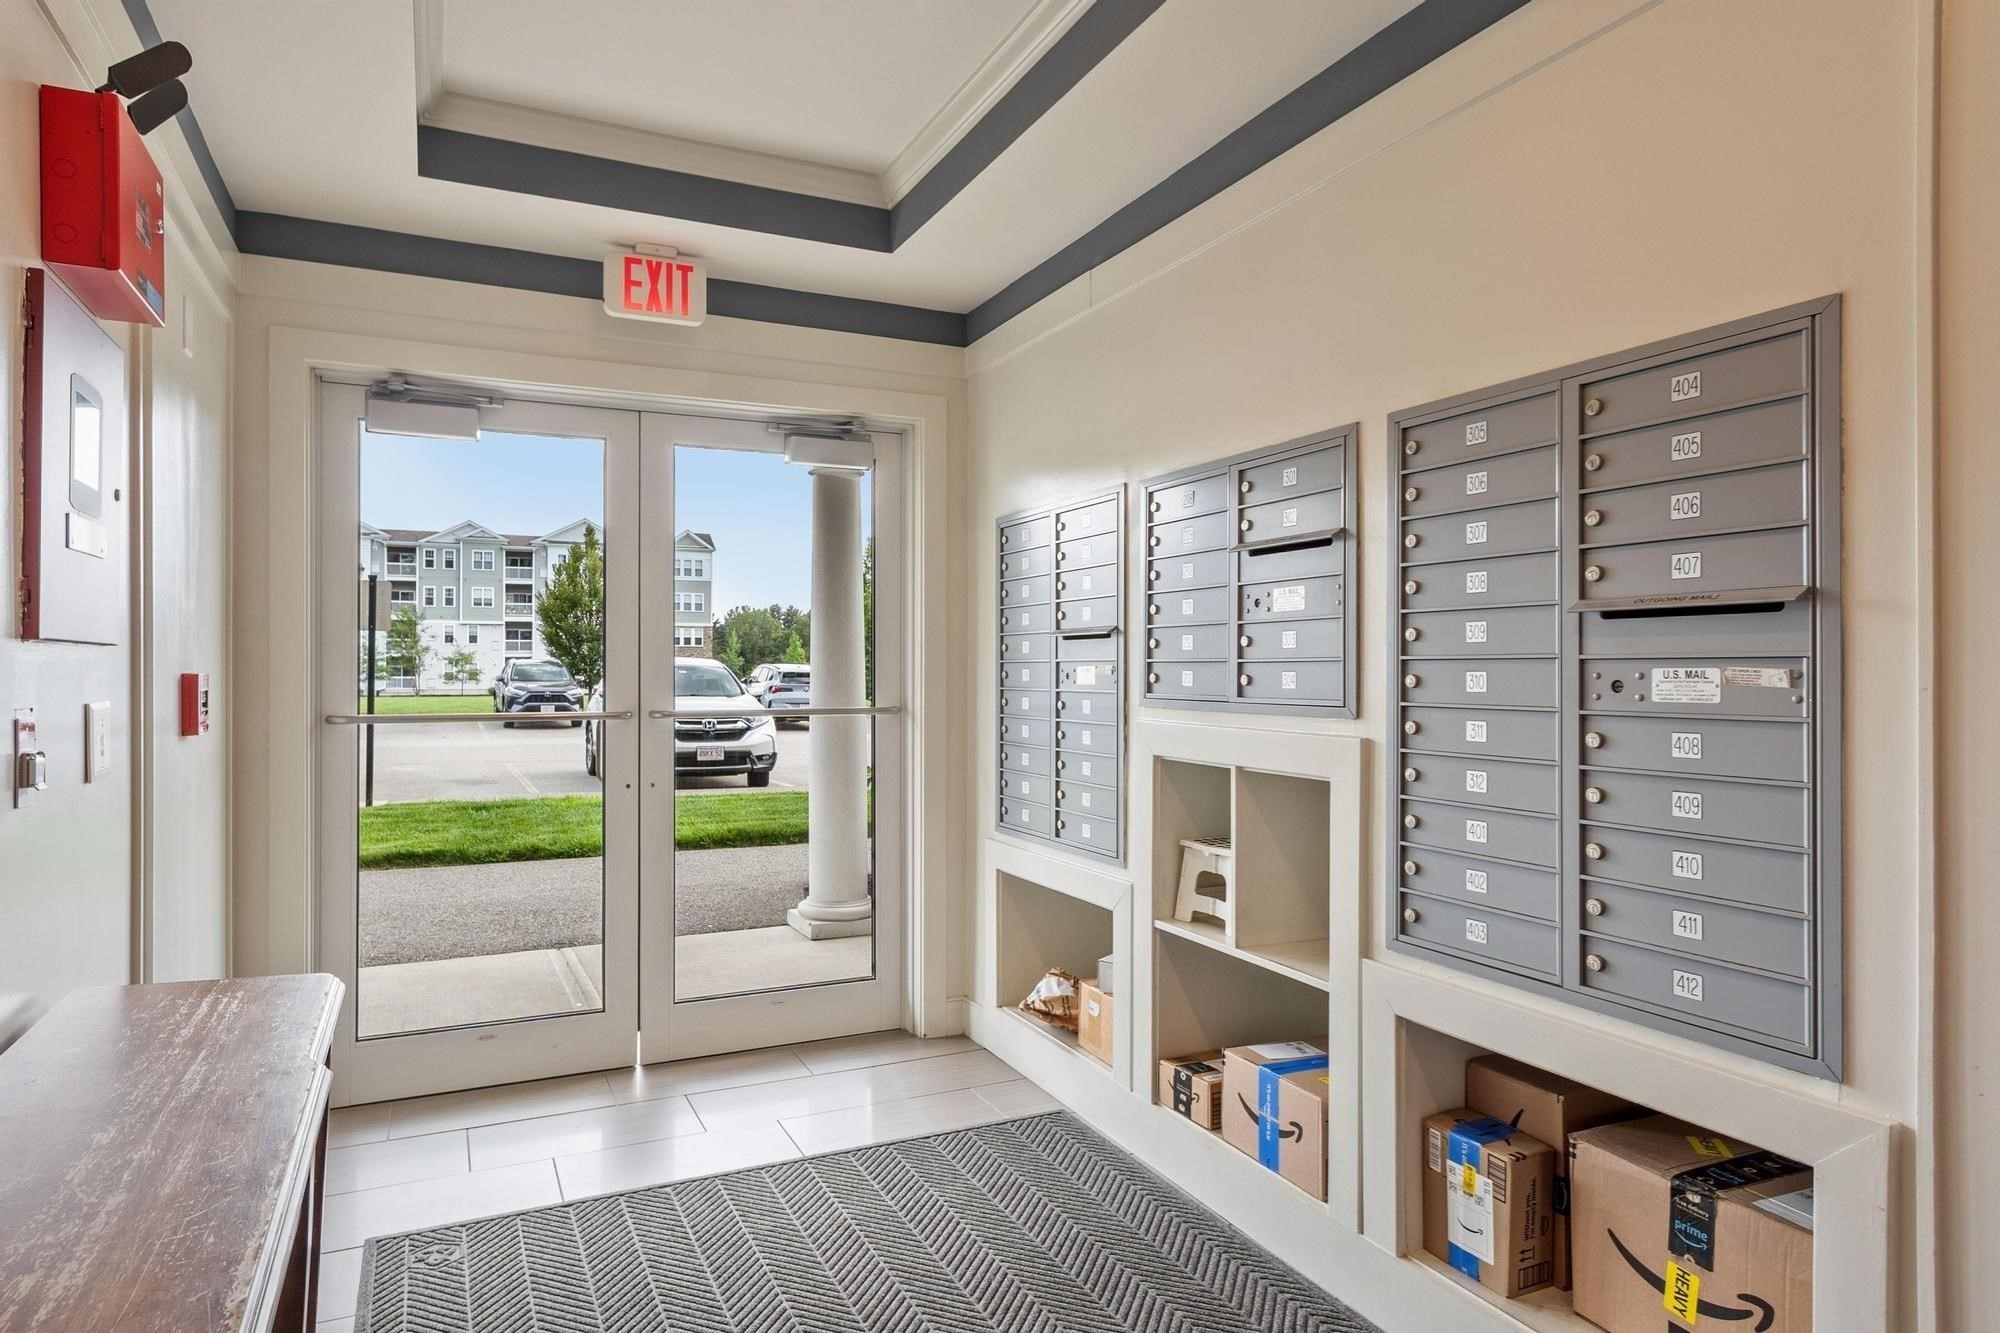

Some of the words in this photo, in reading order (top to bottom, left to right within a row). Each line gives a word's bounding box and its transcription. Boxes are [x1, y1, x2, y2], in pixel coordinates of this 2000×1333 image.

[623, 256, 694, 316] EXIT
[1673, 375, 1699, 397] 404
[1468, 425, 1486, 441] 305
[1673, 436, 1699, 456] 405
[1284, 469, 1296, 484] 301
[1468, 475, 1486, 491] 306
[1673, 495, 1699, 515] 406
[1468, 524, 1486, 540] 307
[1673, 555, 1699, 575] 407
[1468, 574, 1486, 590] 308
[1468, 624, 1486, 640] 309
[1283, 673, 1296, 687] 304
[1468, 674, 1485, 690] 310
[1663, 670, 1681, 679] U.S.
[1685, 670, 1709, 679] MAIL
[1469, 723, 1484, 739] 311
[1674, 736, 1699, 755] 408
[1468, 773, 1485, 789] 312
[1674, 796, 1700, 815] 409
[1468, 823, 1485, 839] 401
[1676, 856, 1698, 875] 410
[1468, 873, 1486, 890] 402
[1468, 923, 1486, 940] 403
[1677, 915, 1697, 935] 411
[1676, 975, 1698, 996] 412
[1674, 1220, 1708, 1242] prime
[1673, 1267, 1691, 1319] HEAVY
